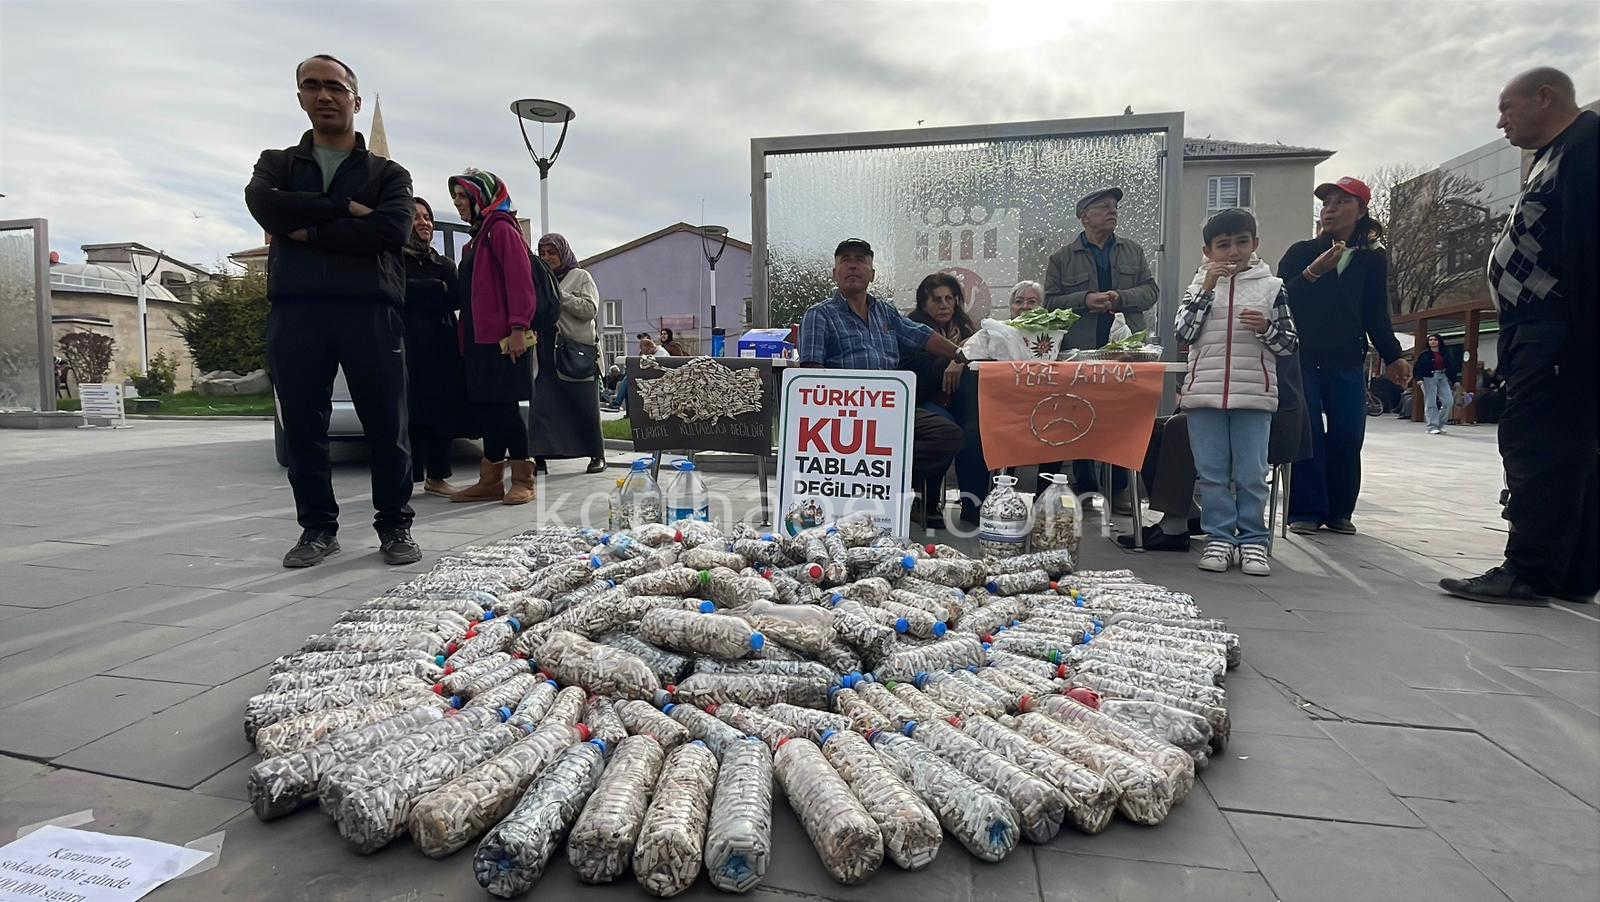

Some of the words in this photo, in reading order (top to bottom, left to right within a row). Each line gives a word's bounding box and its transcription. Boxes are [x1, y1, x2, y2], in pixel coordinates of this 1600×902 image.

[1070, 362, 1136, 386] ATMA
[799, 385, 896, 408] TÜRKİYE
[798, 409, 892, 456] KÜL
[795, 456, 891, 478] TABLASI
[62, 868, 86, 881] bir
[79, 873, 131, 890] günde
